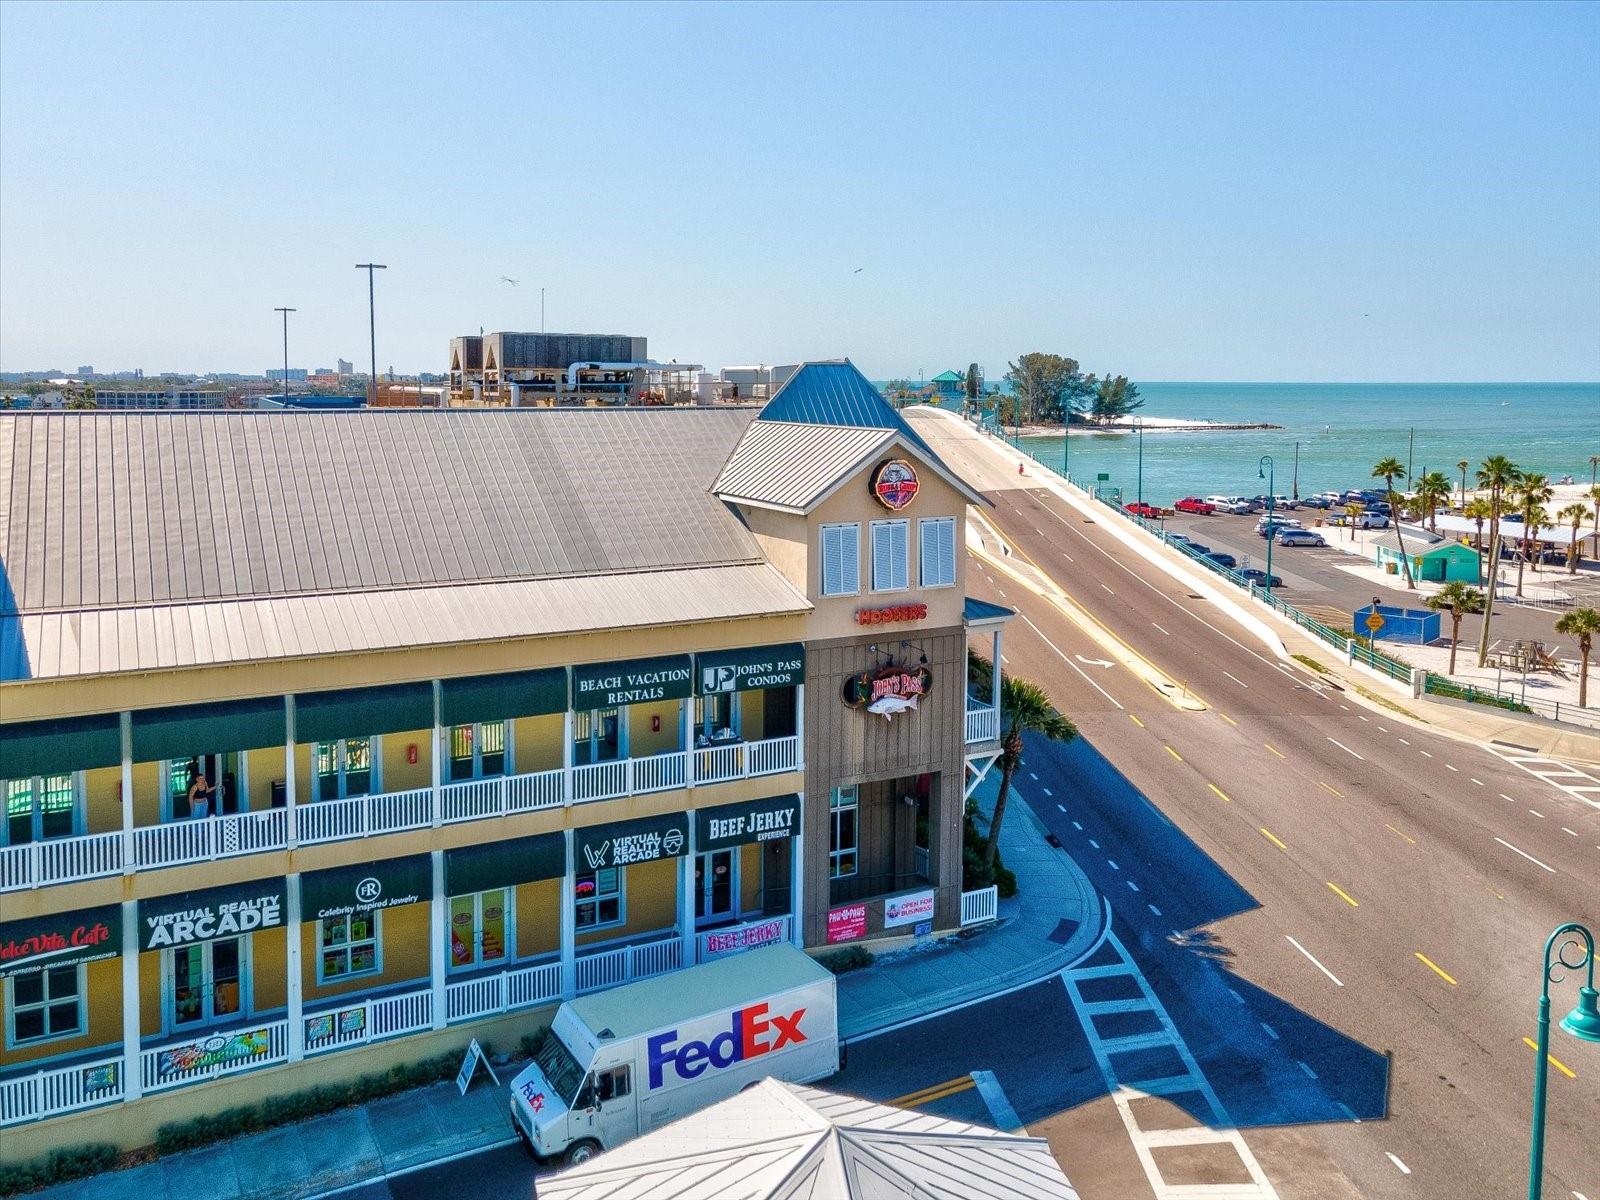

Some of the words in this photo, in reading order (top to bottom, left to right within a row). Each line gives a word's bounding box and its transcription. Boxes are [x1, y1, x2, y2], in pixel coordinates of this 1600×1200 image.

[858, 604, 927, 625] HOOTERS
[736, 662, 772, 677] JOHN'S
[777, 659, 802, 671] PASS
[580, 676, 621, 692] BEACH
[627, 668, 690, 688] VACATION
[747, 673, 791, 687] CONDOS
[608, 687, 664, 704] RENTALS
[709, 816, 745, 840] BEEF
[747, 808, 794, 833] JERKY
[612, 831, 661, 848] VIRTUAL
[757, 829, 790, 842] EXPERIENCE
[612, 849, 660, 865] ARCADE
[613, 840, 661, 857] REALITY
[147, 907, 215, 929] VIRTUAL
[219, 895, 280, 915] REALITY
[318, 904, 355, 918] Celebrity
[356, 898, 388, 912] Inspired
[388, 894, 419, 906] Jewelry
[901, 901, 918, 910] OPEN
[920, 897, 933, 905] FOR
[147, 904, 281, 949] ARCADE
[707, 931, 740, 953] BEEF
[741, 920, 782, 946] JERKY
[0, 941, 30, 960] olce
[647, 1002, 808, 1090] FedEx
[520, 1080, 545, 1113] FedEx
